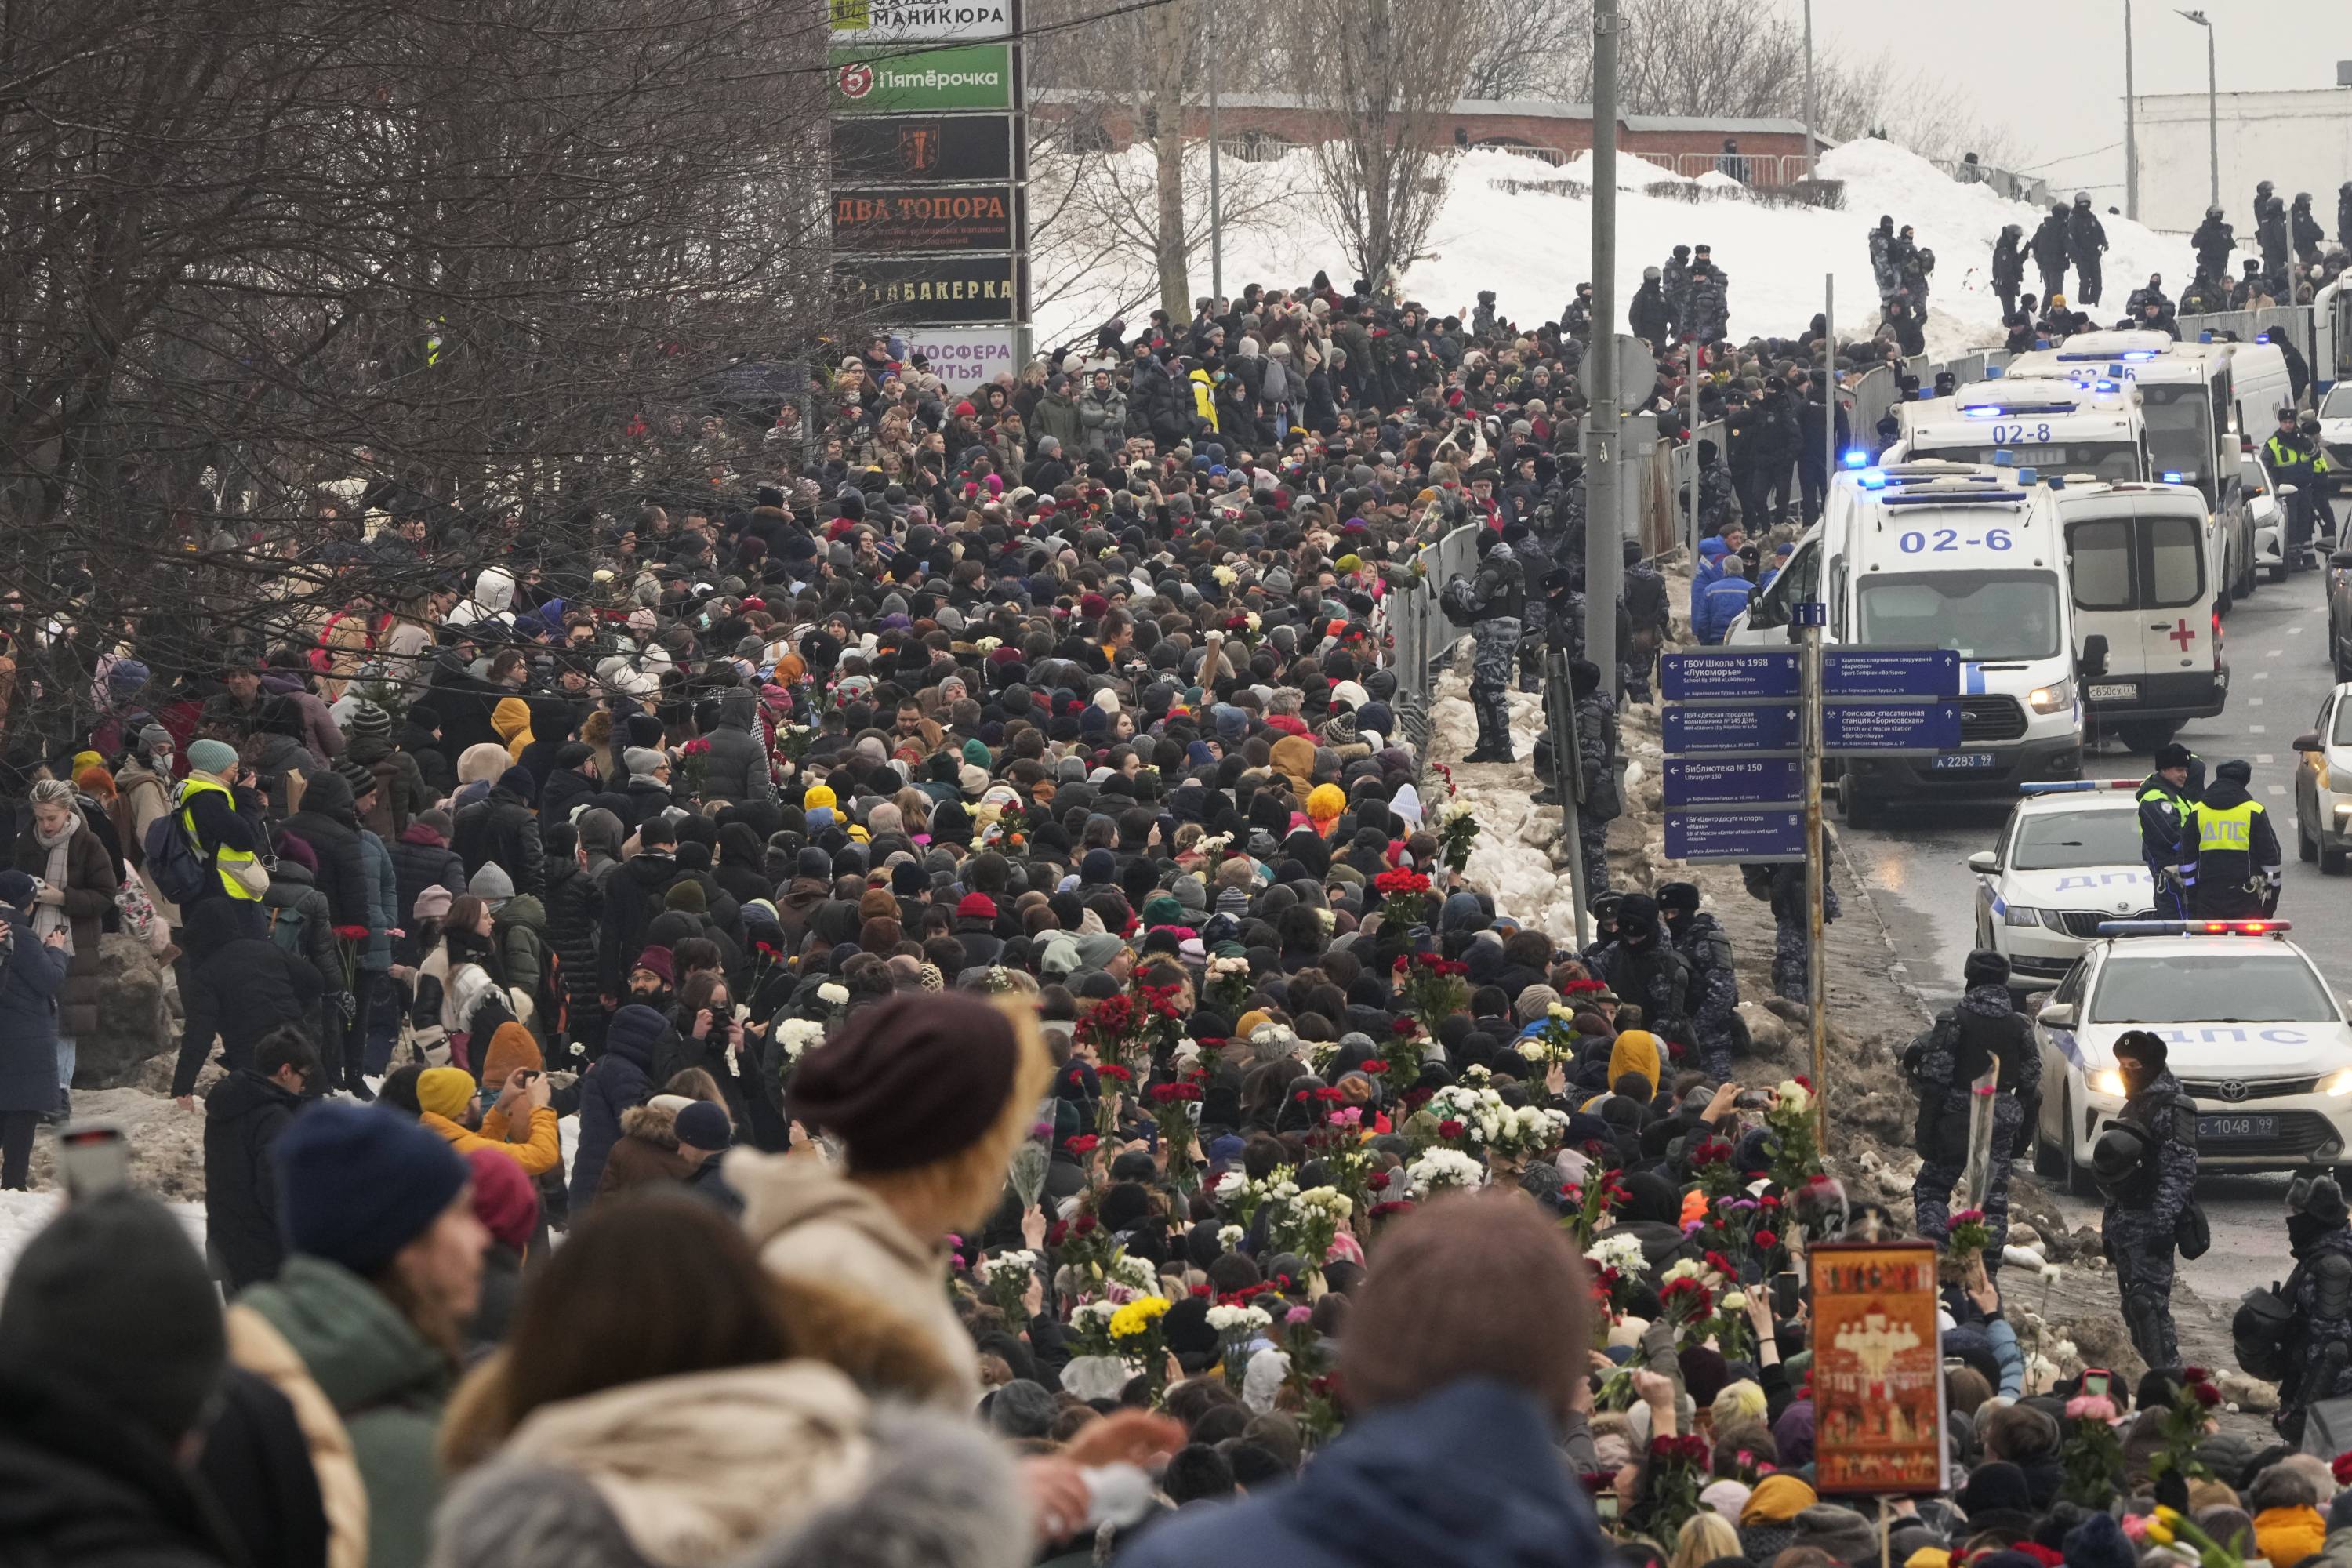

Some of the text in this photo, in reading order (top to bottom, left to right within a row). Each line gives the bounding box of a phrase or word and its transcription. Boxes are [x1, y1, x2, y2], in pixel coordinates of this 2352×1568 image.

[874, 8, 1004, 25] МАНИКЮРА
[880, 70, 998, 90] Пятёрочка
[837, 197, 1004, 225] ДВА ТОПОРА
[909, 344, 1010, 360] МОСФЕРА
[931, 364, 983, 379] ИТЬЯ
[1993, 423, 2050, 444] 02-8
[1900, 528, 2012, 553] 02-6
[1684, 659, 1704, 668] ГБОУ
[1684, 669, 1741, 678] «Лукоморье»
[1685, 764, 1735, 773] Библиотека
[1937, 759, 1944, 768] А
[1947, 756, 1974, 768] 2283
[2201, 821, 2246, 841] ДПС
[2214, 1119, 2249, 1134] 1048
[2259, 1118, 2272, 1130] 99
